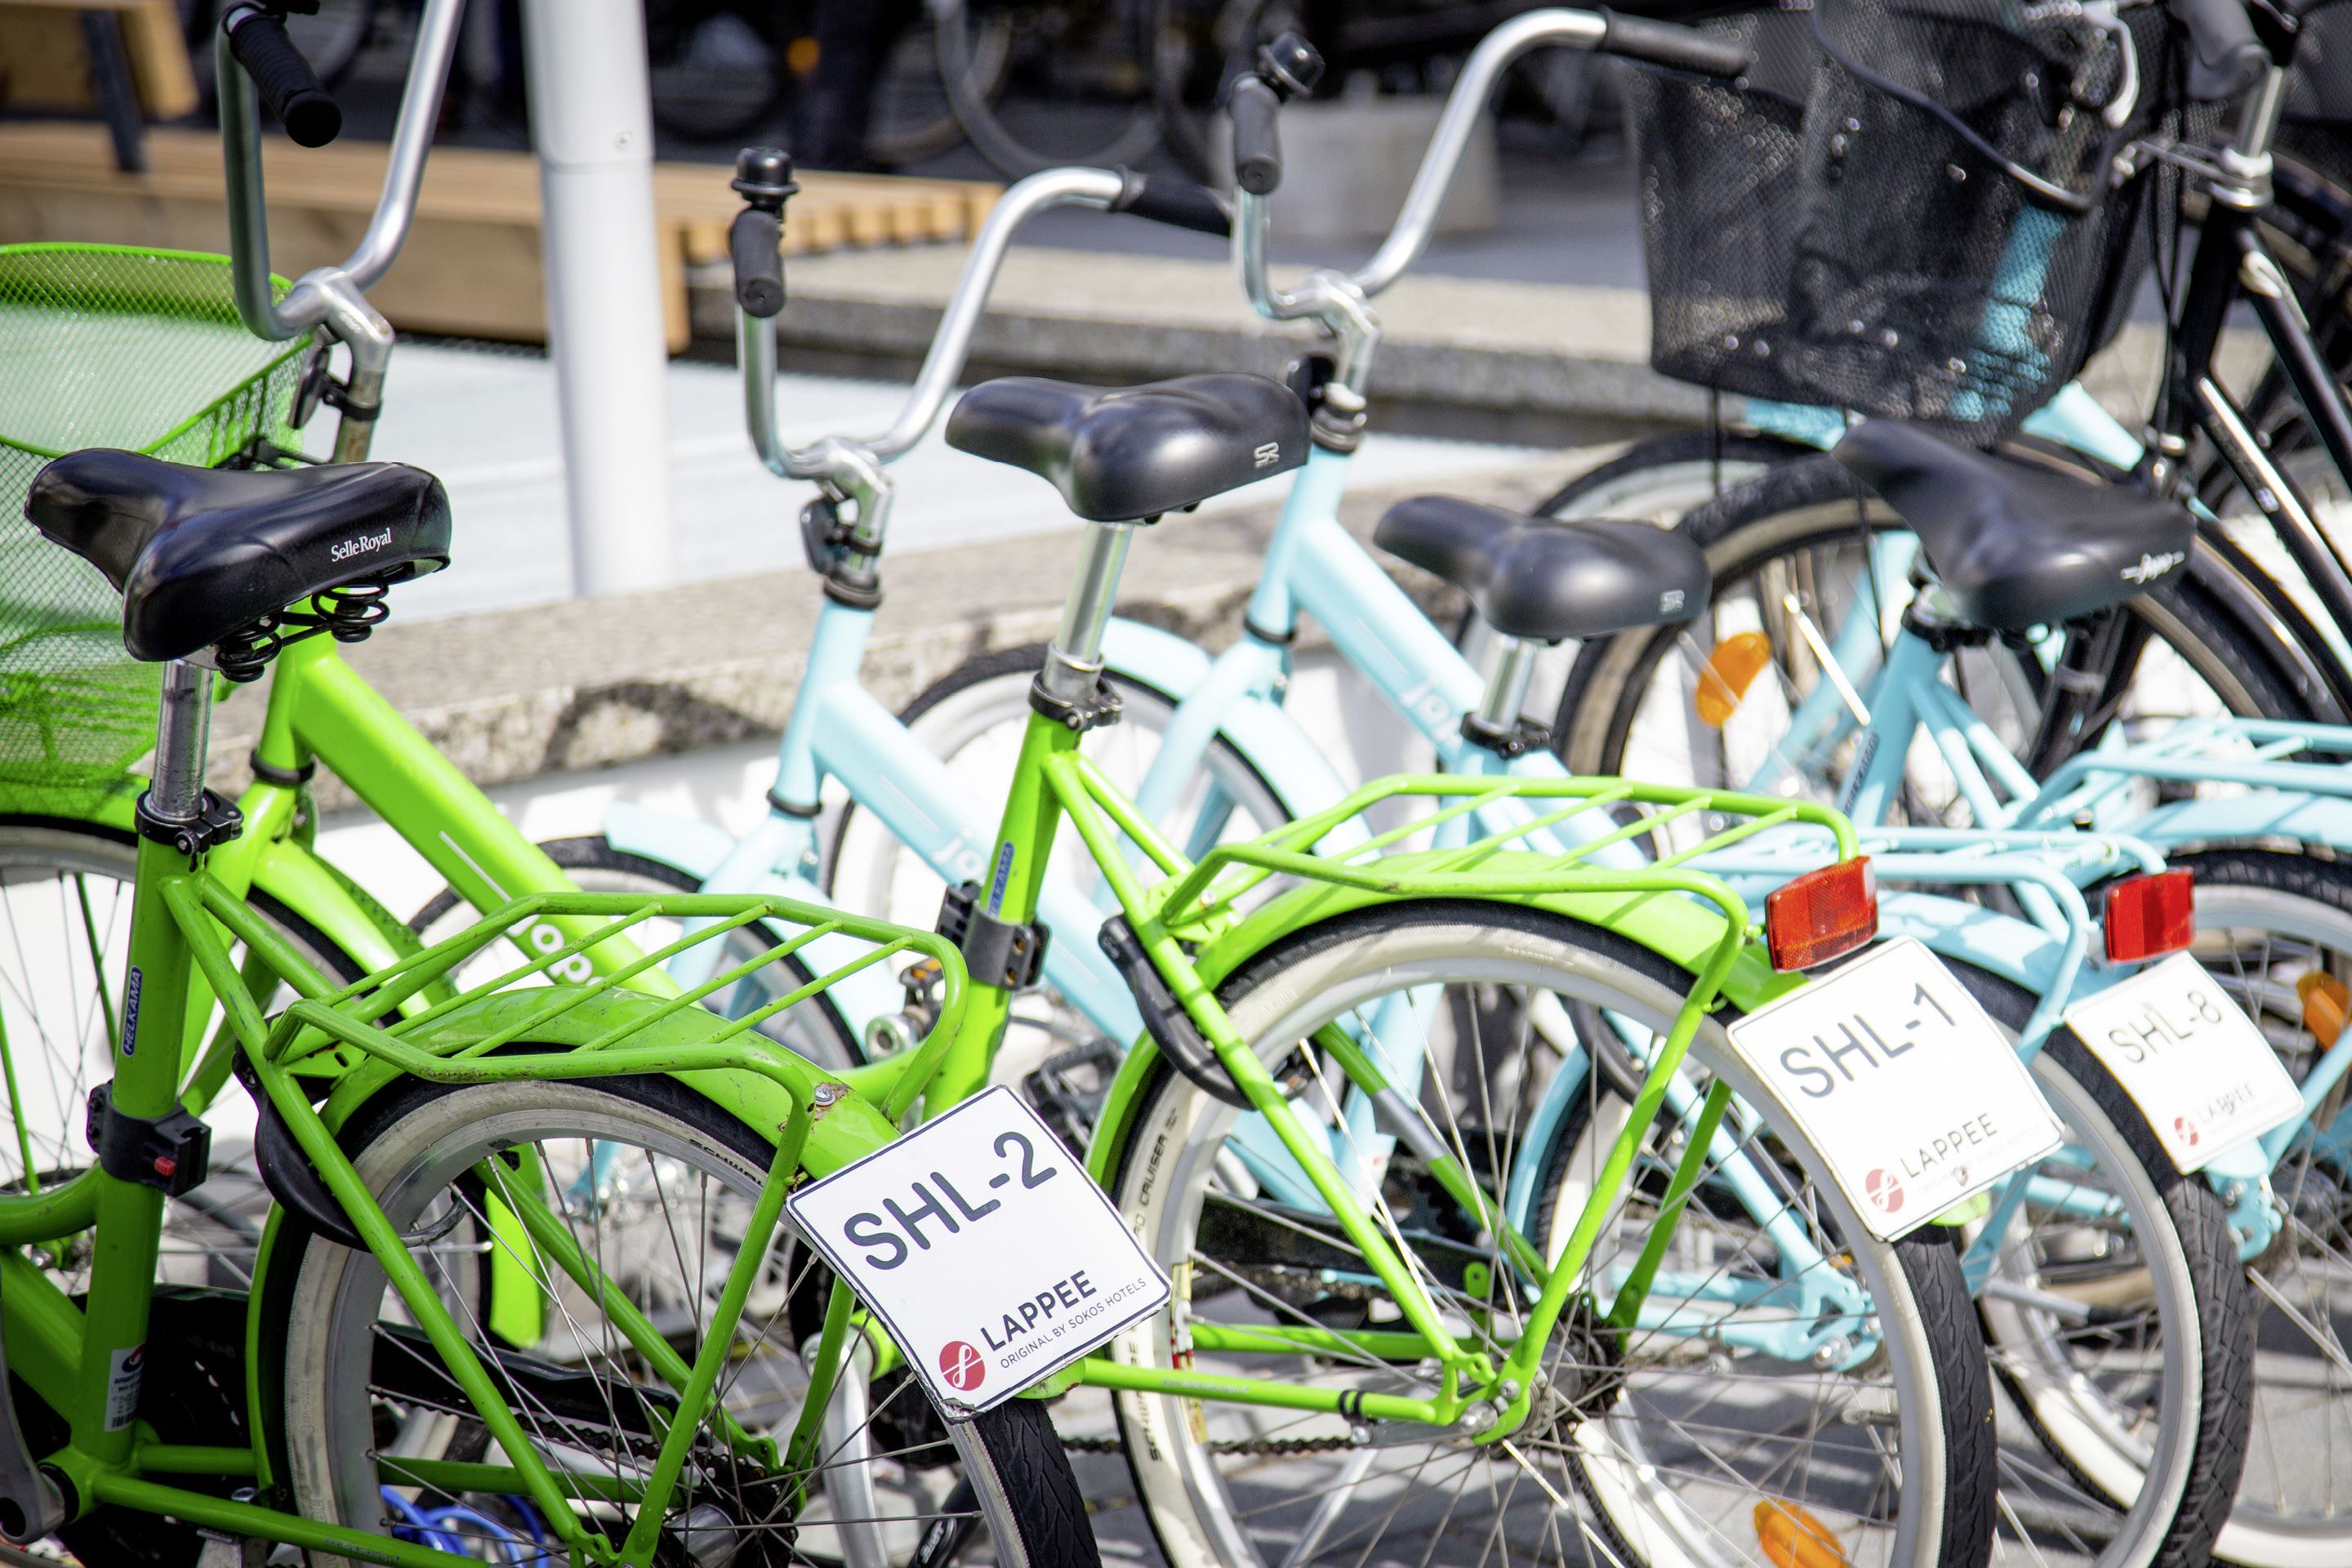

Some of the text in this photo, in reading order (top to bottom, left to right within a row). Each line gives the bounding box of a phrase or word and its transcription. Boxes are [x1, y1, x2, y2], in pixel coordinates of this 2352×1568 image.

[124, 970, 142, 1053] HELKAMA
[1780, 982, 1956, 1098] SHL-1
[2108, 991, 2222, 1063] SHL-8
[1139, 1133, 1169, 1206] CRUISER
[1900, 1112, 1998, 1178] LAPPEE
[843, 1130, 1058, 1271] SHL-2
[980, 1269, 1098, 1352] LAPPEE
[1000, 1277, 1147, 1369] ORIGINAL BY SOKOS HOTELS
